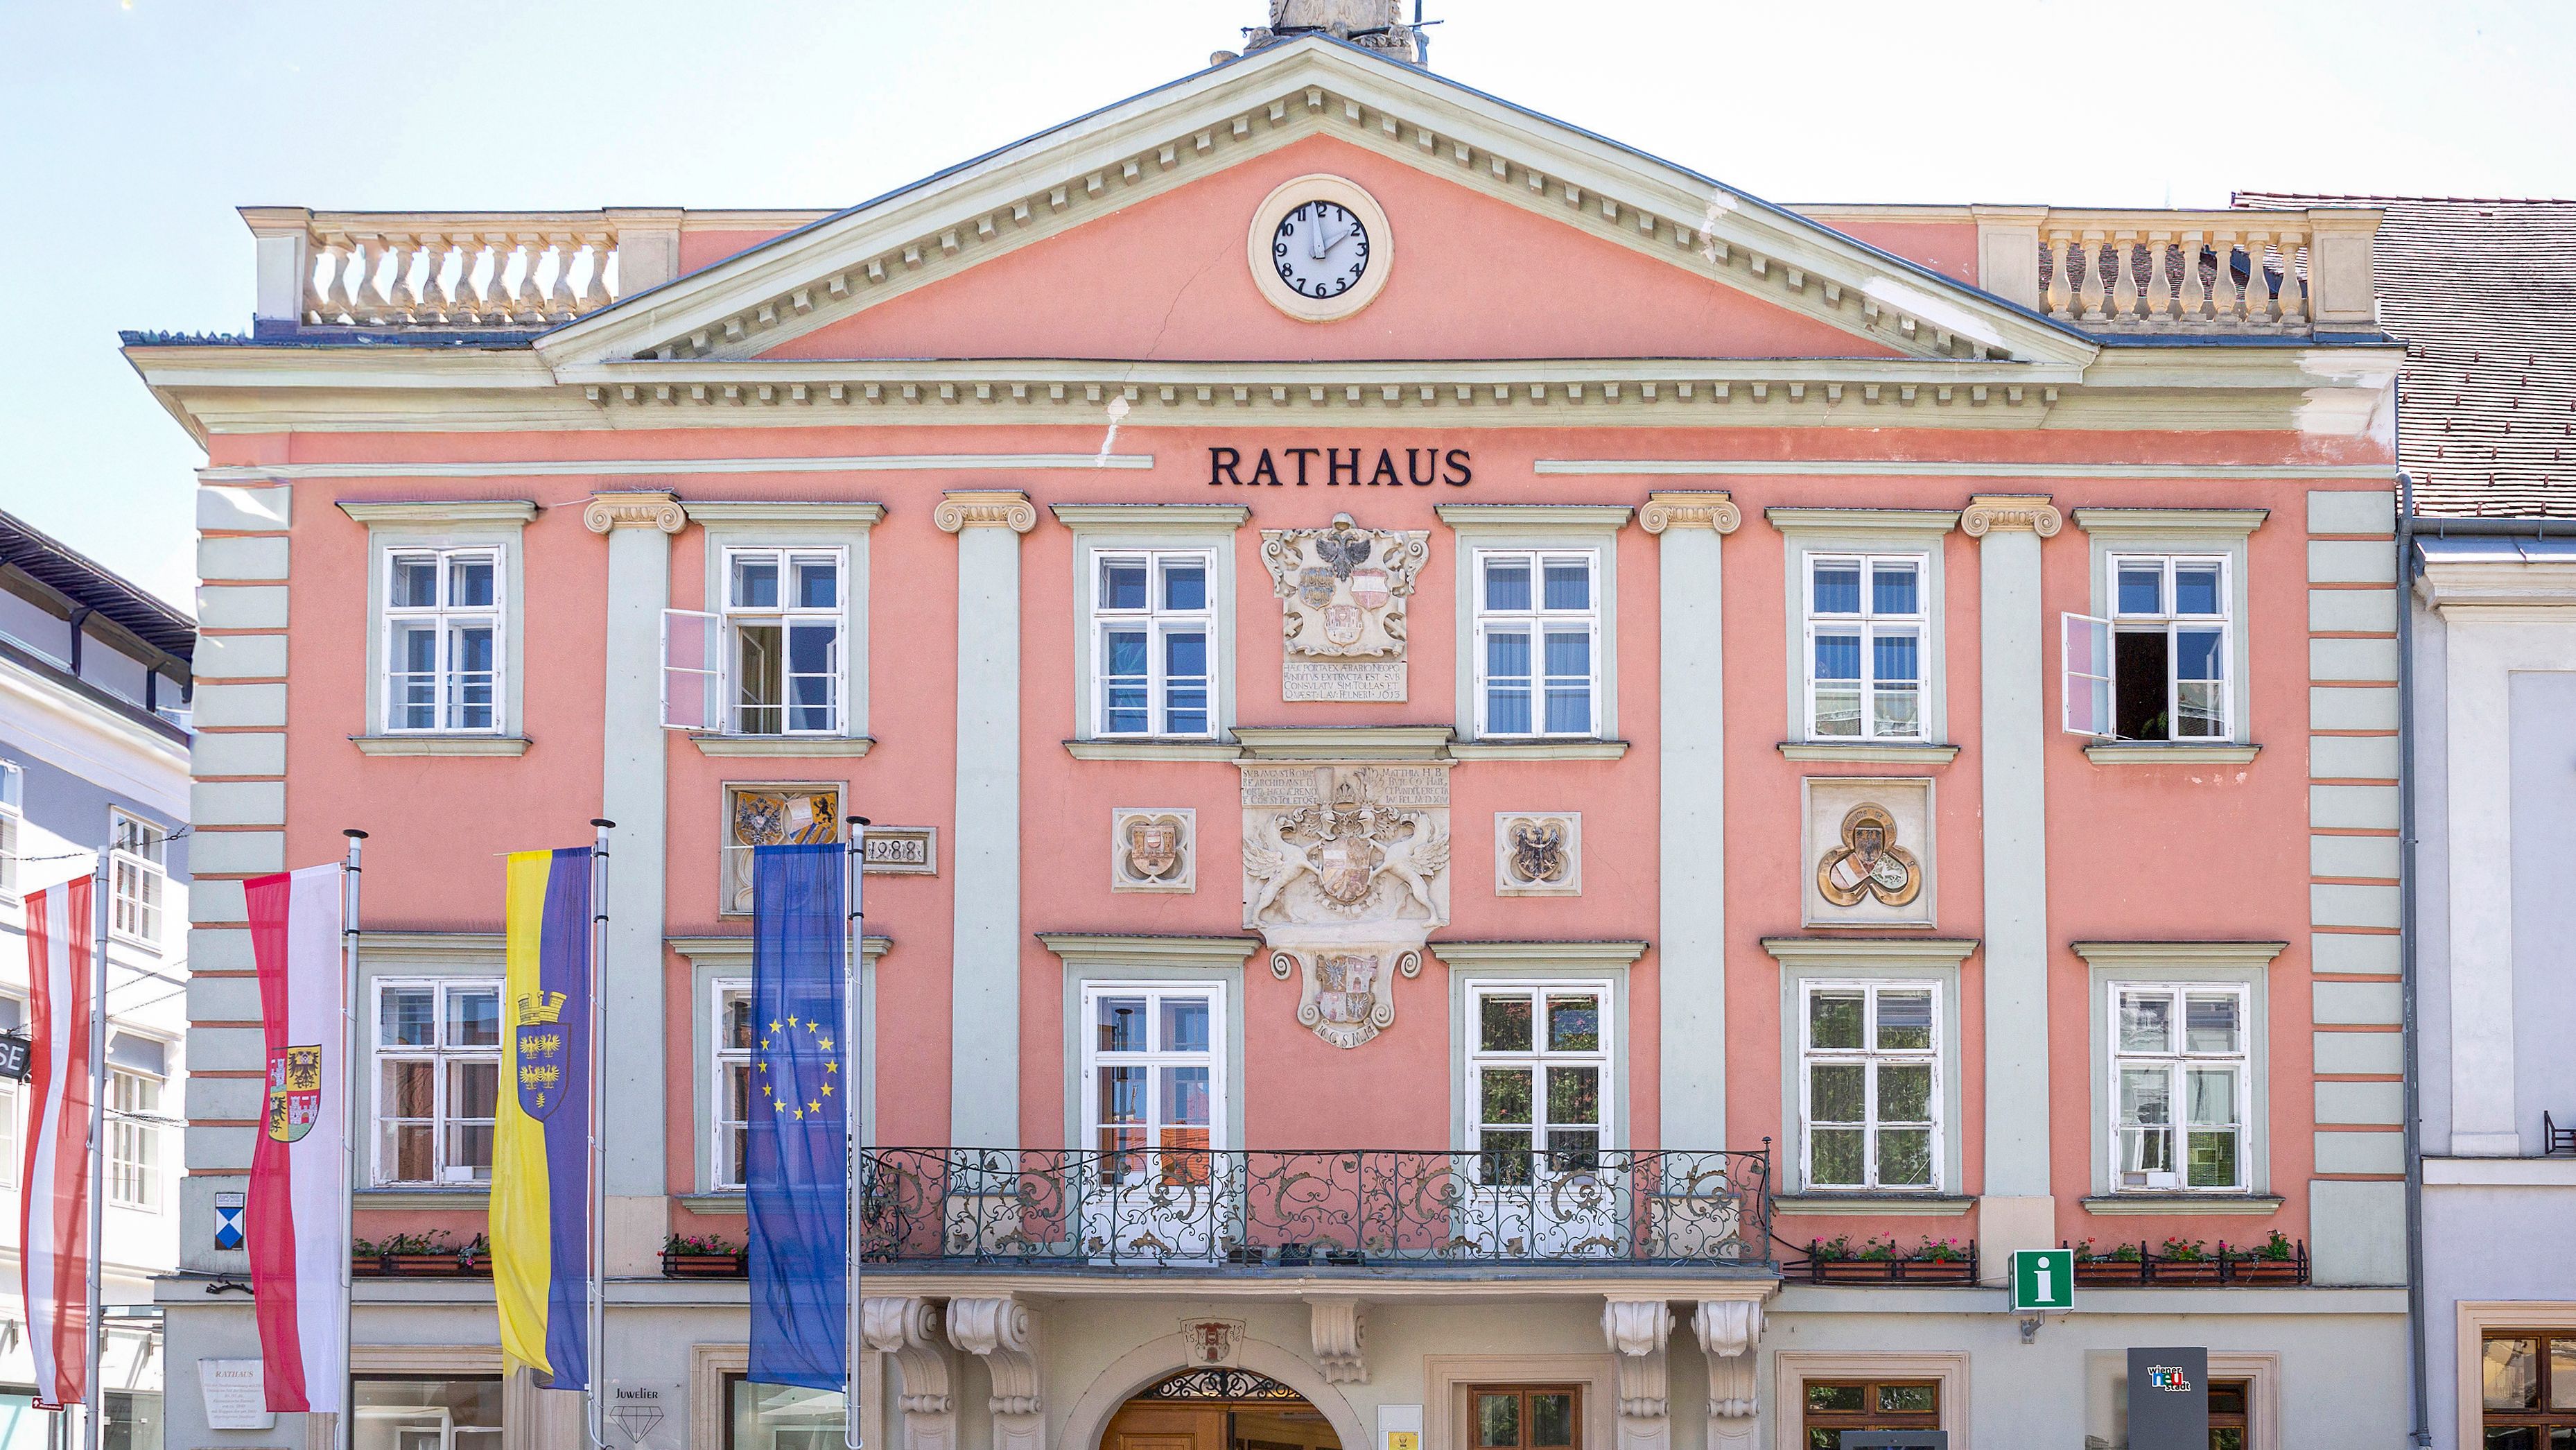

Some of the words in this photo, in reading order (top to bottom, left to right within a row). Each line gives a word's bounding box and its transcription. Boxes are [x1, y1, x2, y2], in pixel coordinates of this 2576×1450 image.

[1298, 208, 1306, 221] 11
[1337, 208, 1342, 222] 1
[1281, 223, 1294, 236] 10
[1350, 223, 1360, 236] 2
[1276, 243, 1287, 257] 9
[1355, 243, 1367, 257] 3
[1282, 263, 1293, 277] 8
[1349, 263, 1361, 277] 4
[1296, 278, 1306, 292] 7
[1316, 283, 1327, 297] 6
[1336, 277, 1346, 291] 5
[1208, 447, 1473, 486] RATHAUS
[2149, 1365, 2182, 1374] wiener
[2153, 1373, 2182, 1386] neu
[2166, 1381, 2189, 1390] stadt
